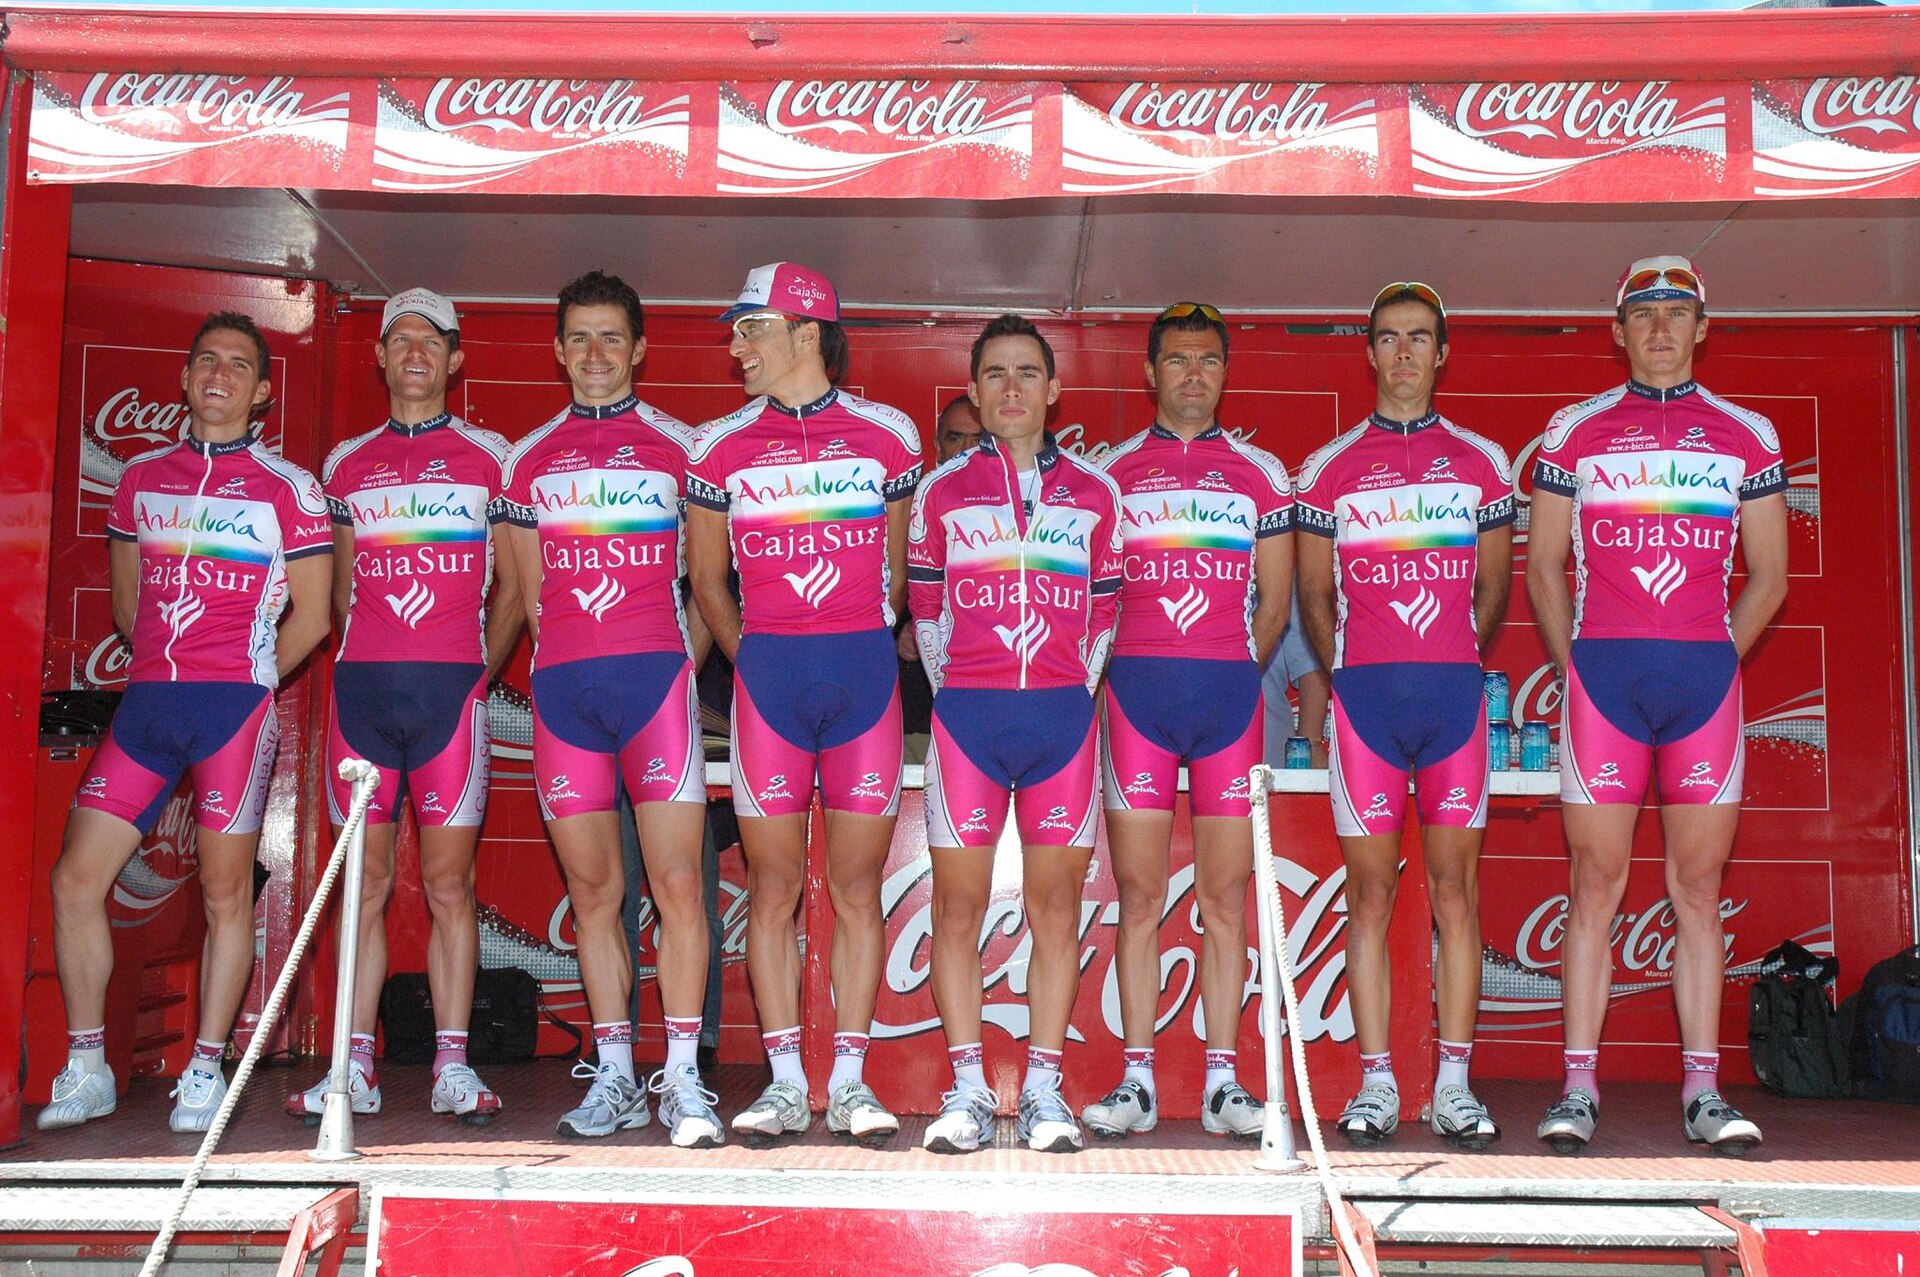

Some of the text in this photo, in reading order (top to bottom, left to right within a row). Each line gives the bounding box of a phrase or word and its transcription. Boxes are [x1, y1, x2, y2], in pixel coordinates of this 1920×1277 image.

[1586, 137, 1608, 145] Marca
[788, 285, 826, 301] CajaSur
[1611, 435, 1655, 443] ORBEA
[1675, 438, 1715, 451] Spiuk
[1606, 442, 1660, 452] www.e-bici.com
[751, 456, 802, 466] www.e-bici.com
[818, 449, 858, 460] Spiuk
[547, 461, 590, 473] www.e-bici.com
[605, 458, 645, 468] Spiuk
[417, 472, 455, 482] Spiuk
[1421, 471, 1459, 482] Spiuk
[1589, 459, 1732, 494] Andalucía
[737, 467, 880, 505] Andalucía
[1132, 481, 1181, 492] www.e-bici.com
[1196, 479, 1233, 491] Spiuk
[1357, 478, 1406, 490] www.e-bici.com
[215, 486, 248, 498] Spiuk
[534, 477, 667, 513] Andalucía
[352, 491, 476, 525] Andalucía
[1121, 497, 1251, 531] Andalucía
[1344, 492, 1471, 531] Andalucía
[137, 502, 263, 543] Andalucía
[950, 515, 1087, 553] Andalucía
[1592, 518, 1725, 553] CajaSur
[741, 524, 878, 562] CajaSur
[543, 538, 665, 576] CajaSur
[356, 547, 474, 583] CajaSur
[1123, 552, 1246, 586] CajaSur
[1349, 552, 1469, 589] CajaSur
[140, 558, 256, 592] CajaSur
[954, 575, 1083, 612] CajaSur
[641, 773, 677, 785] Spiuk
[1588, 777, 1626, 789] Spiuk
[1679, 776, 1720, 788] Spiuk
[546, 790, 581, 803] Spiuk
[758, 790, 794, 802] Spiuk
[850, 786, 889, 800] Spiuk
[1124, 785, 1160, 796] Spiuk
[1438, 801, 1474, 812] Spiuk
[1362, 808, 1394, 821] Spiuk
[958, 822, 991, 833] Spiuk
[1037, 819, 1076, 832] Spiuk
